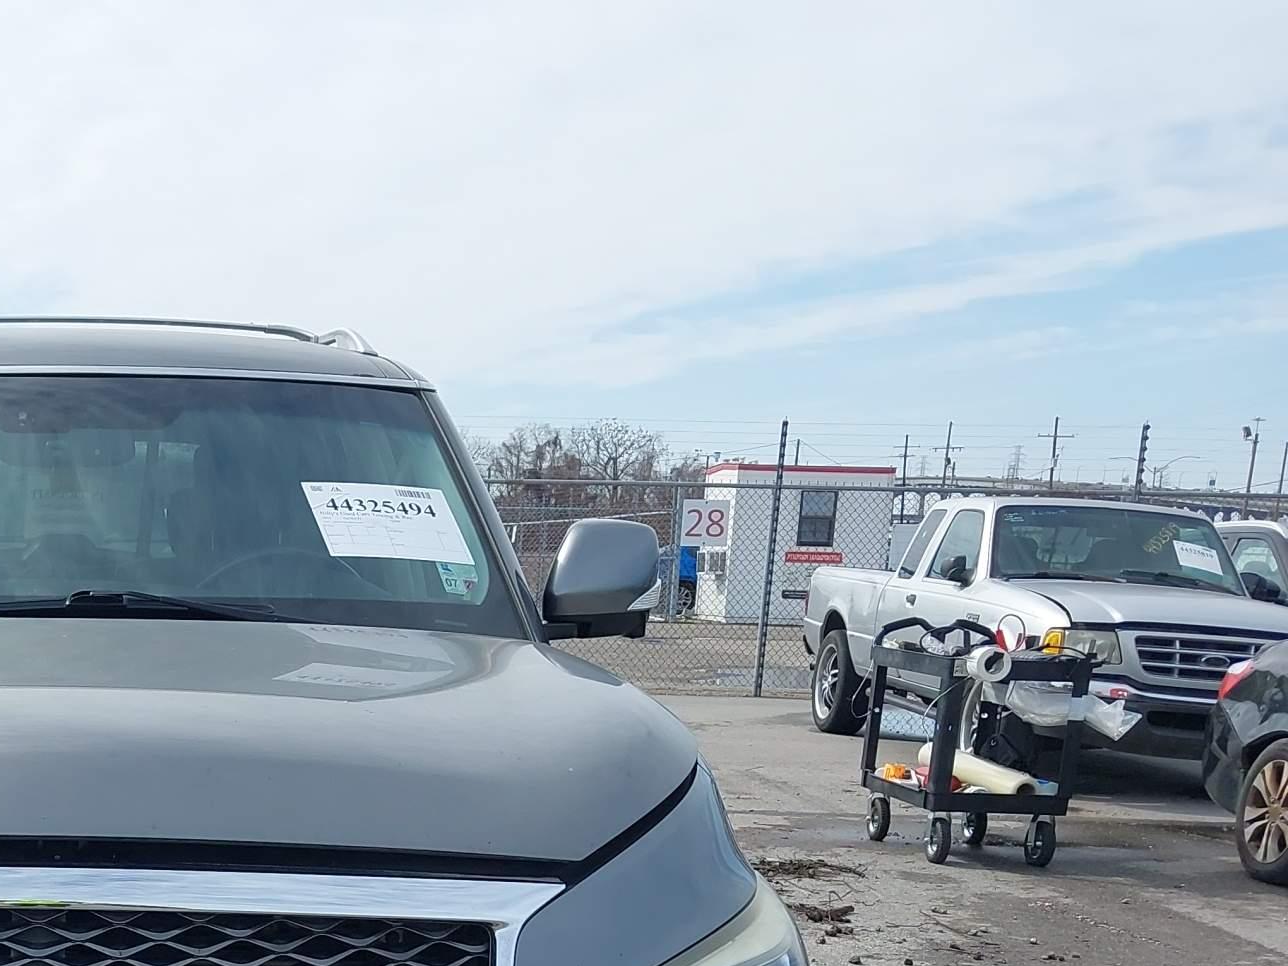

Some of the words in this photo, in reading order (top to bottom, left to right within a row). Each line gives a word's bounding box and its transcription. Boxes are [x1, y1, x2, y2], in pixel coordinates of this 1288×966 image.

[325, 497, 437, 518] 44325494
[684, 508, 725, 538] 28
[445, 577, 458, 589] 07
